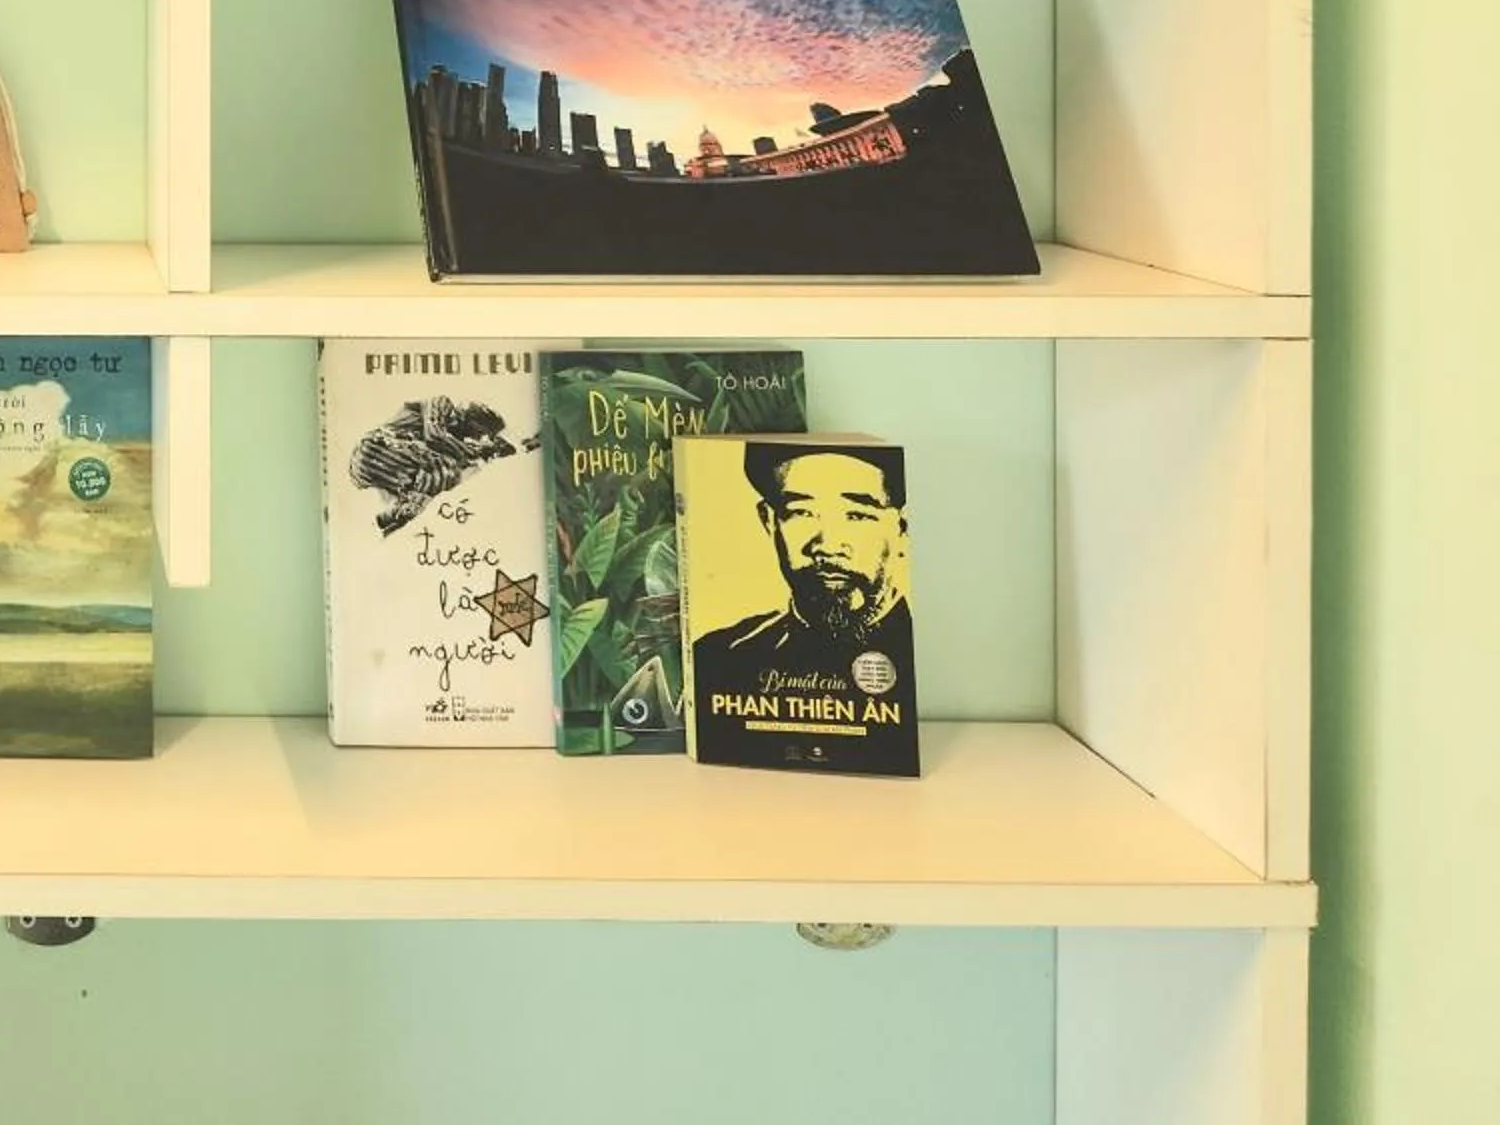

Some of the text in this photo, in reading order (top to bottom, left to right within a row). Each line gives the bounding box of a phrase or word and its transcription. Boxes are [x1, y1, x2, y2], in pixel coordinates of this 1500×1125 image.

[19, 355, 78, 377] ngọc
[473, 352, 532, 375] LEVI
[715, 372, 738, 390] TÔ
[589, 390, 628, 440] Dế
[437, 499, 475, 524] có
[414, 526, 500, 577] được
[439, 580, 479, 619] là
[409, 636, 516, 692] người
[711, 694, 901, 725] PHAN THIÊN ÂN
